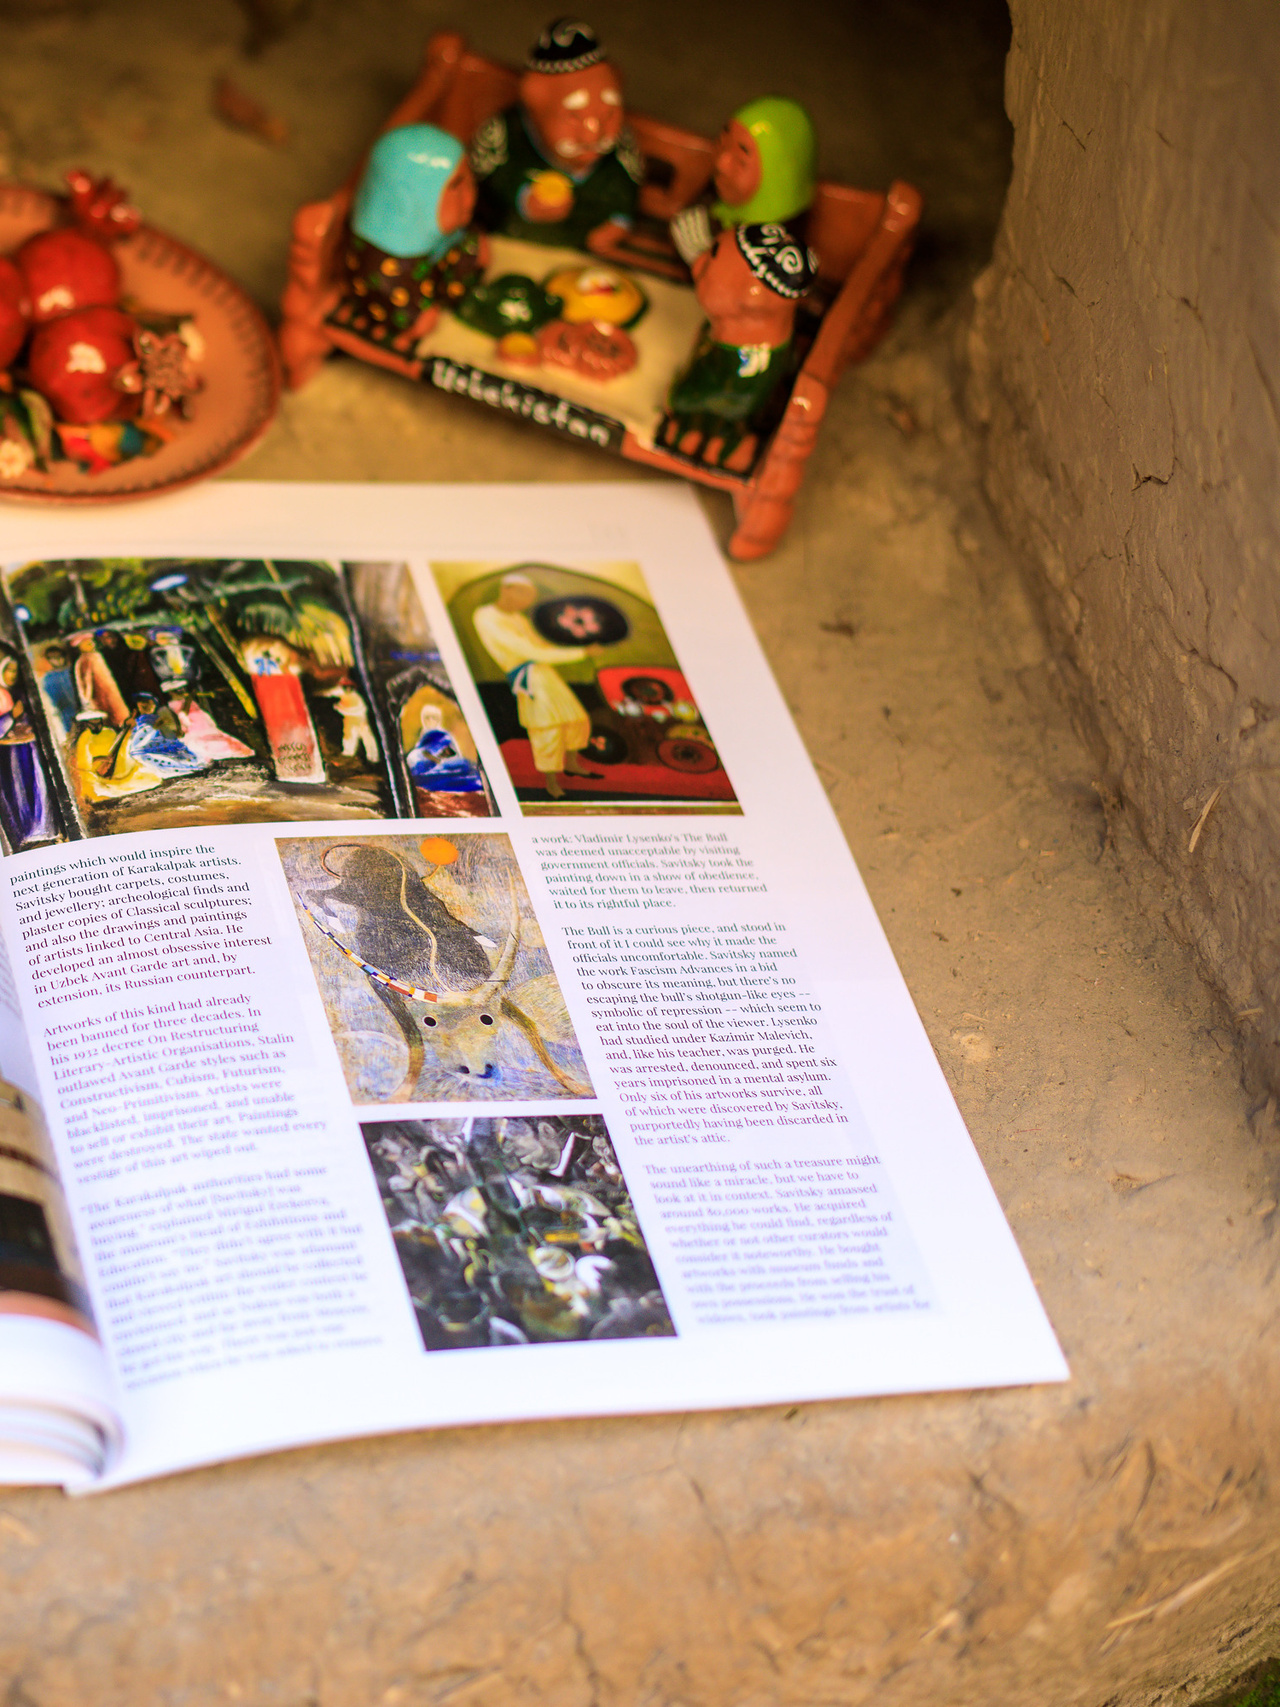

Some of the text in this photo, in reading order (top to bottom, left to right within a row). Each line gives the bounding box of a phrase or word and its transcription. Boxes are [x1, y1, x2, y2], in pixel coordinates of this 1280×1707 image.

[9, 844, 215, 886] paintings which would inspire the
[13, 883, 40, 898] next
[42, 871, 109, 893] generation
[112, 866, 124, 877] of
[127, 856, 196, 875] Karakalpak
[15, 889, 65, 911] Savitsky
[67, 883, 113, 898] bought
[44, 993, 251, 1037] Artworks of this kind had already
[595, 1022, 615, 1032] eat
[615, 1021, 640, 1031] into
[642, 1020, 662, 1030] the
[664, 1019, 690, 1030] soul
[691, 1019, 703, 1029] of
[705, 1018, 725, 1029] the
[770, 1015, 817, 1028] Lysenko
[599, 1035, 623, 1045] had
[625, 1034, 670, 1045] studied
[671, 1033, 706, 1044] under
[709, 1031, 755, 1042] Kazimir
[632, 1048, 655, 1059] like
[655, 1048, 675, 1058] his
[726, 1048, 750, 1056] was
[798, 1044, 815, 1053] He
[633, 1135, 653, 1145] the
[657, 1131, 698, 1145] artist's
